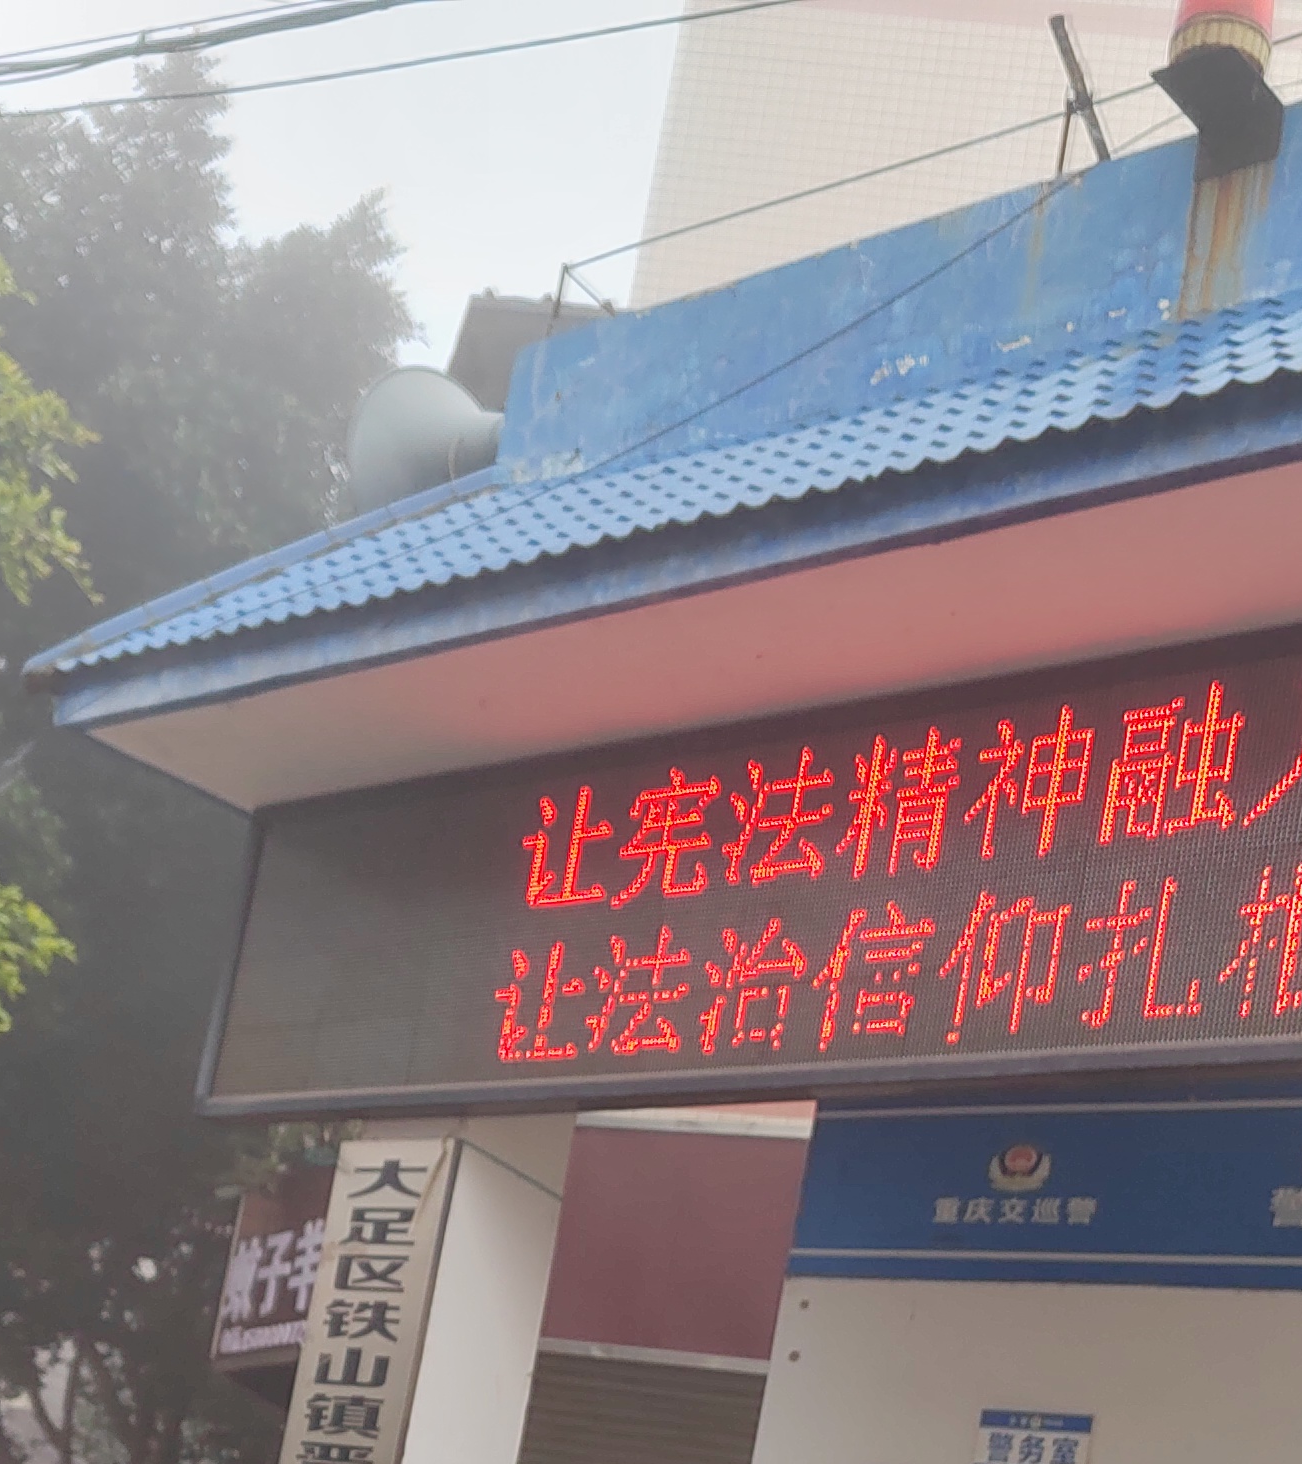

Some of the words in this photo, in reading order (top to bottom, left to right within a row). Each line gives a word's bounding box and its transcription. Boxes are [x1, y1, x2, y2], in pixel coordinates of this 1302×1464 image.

[933, 1196, 1097, 1227] 重庆交巡警
